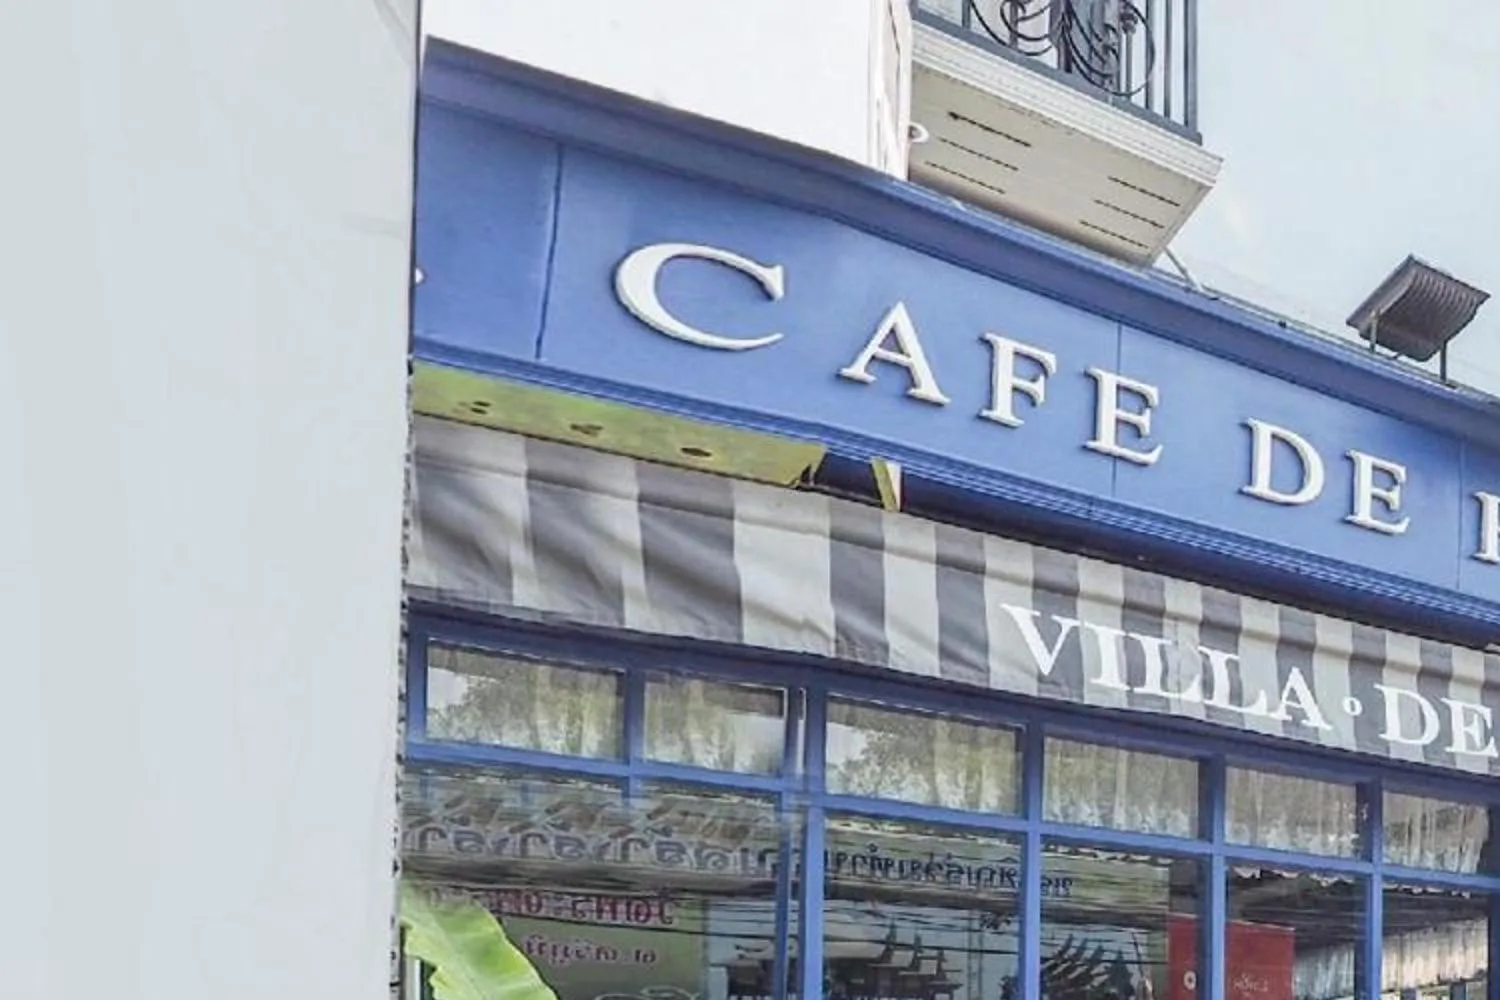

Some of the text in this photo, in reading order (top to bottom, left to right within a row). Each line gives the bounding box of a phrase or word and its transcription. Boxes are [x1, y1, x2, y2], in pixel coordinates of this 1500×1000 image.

[613, 243, 1165, 466] CAFE
[1241, 416, 1410, 534] DE
[1000, 603, 1333, 730] VILLA
[1374, 683, 1499, 758] DE
